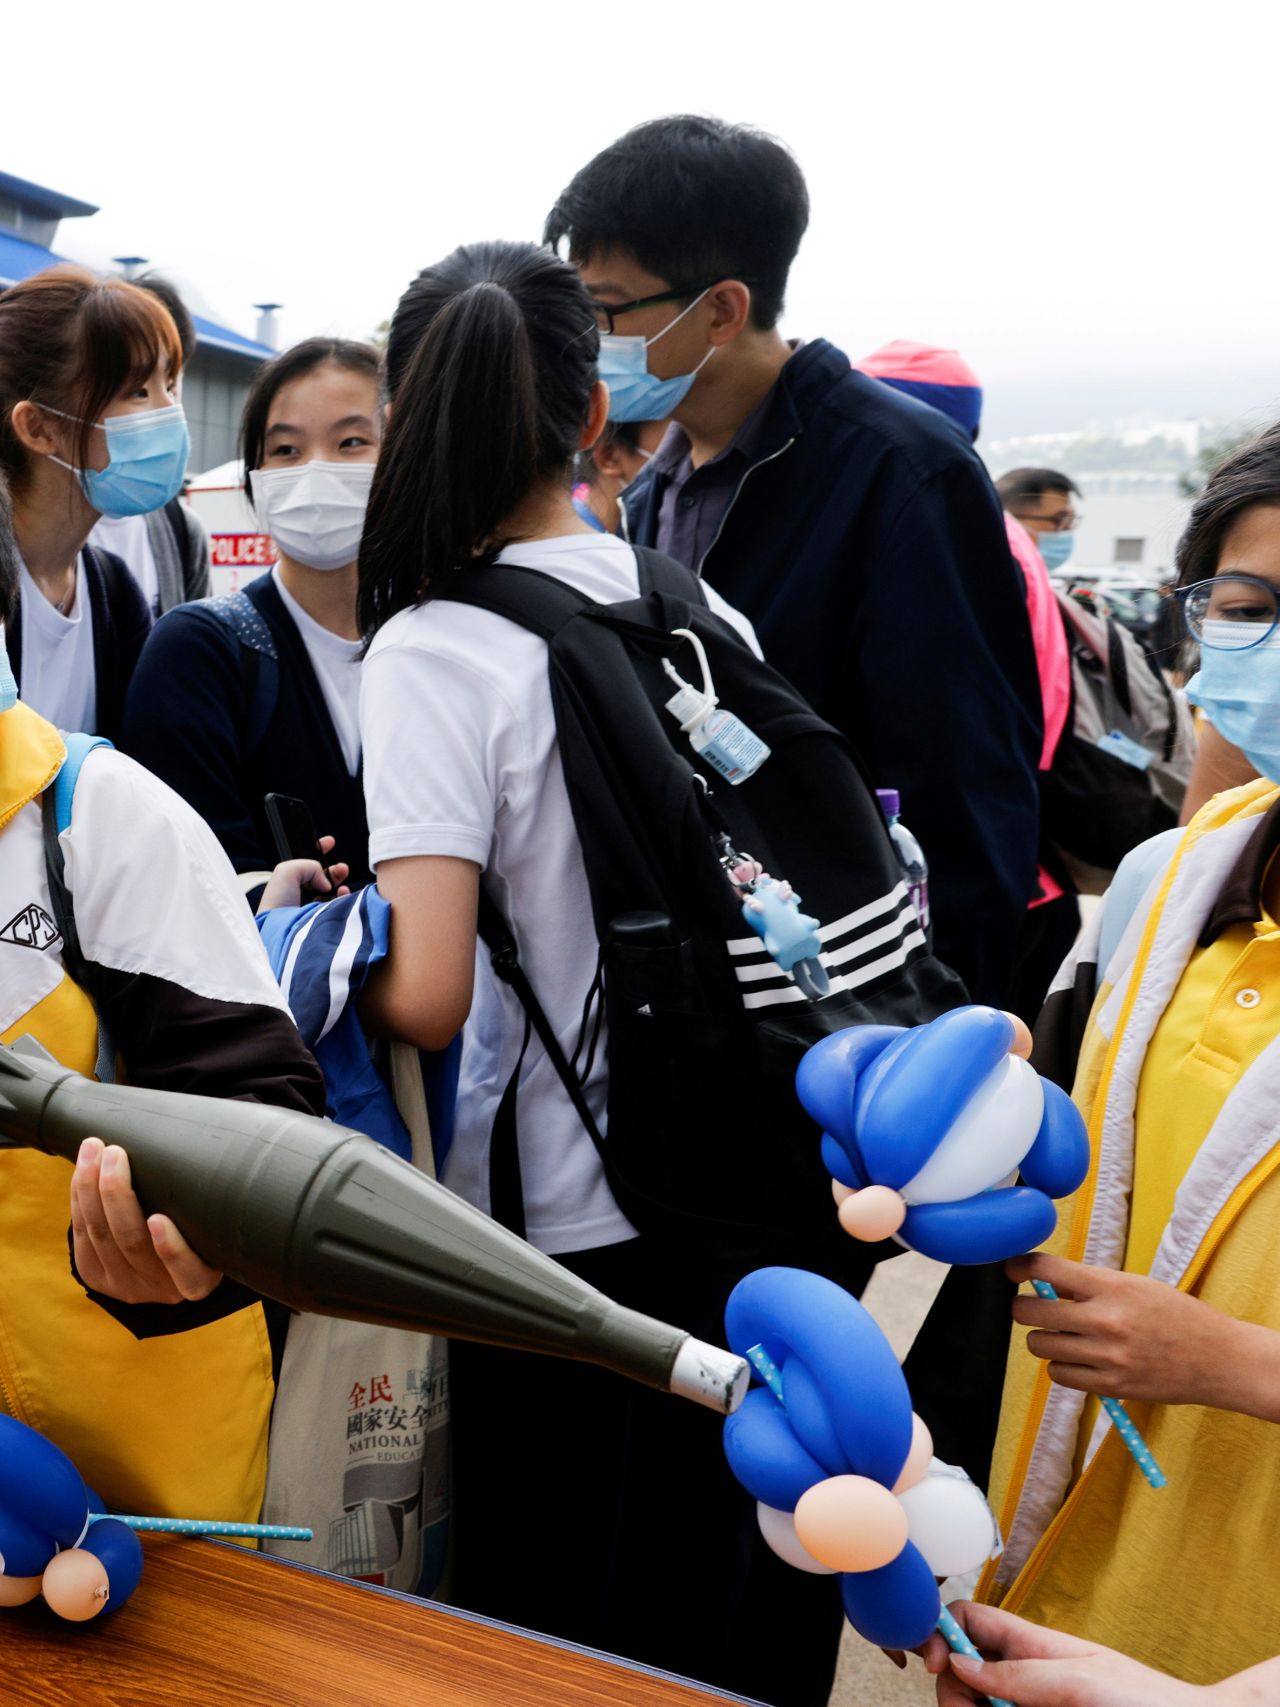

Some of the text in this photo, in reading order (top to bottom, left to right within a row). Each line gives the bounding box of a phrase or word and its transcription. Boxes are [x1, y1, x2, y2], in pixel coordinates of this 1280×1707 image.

[210, 537, 266, 563] POLICE
[347, 1373, 393, 1412] 全民
[346, 1405, 431, 1439] 國家安全
[348, 1434, 421, 1455] NATIONAL
[376, 1448, 423, 1462] EDUCAT
